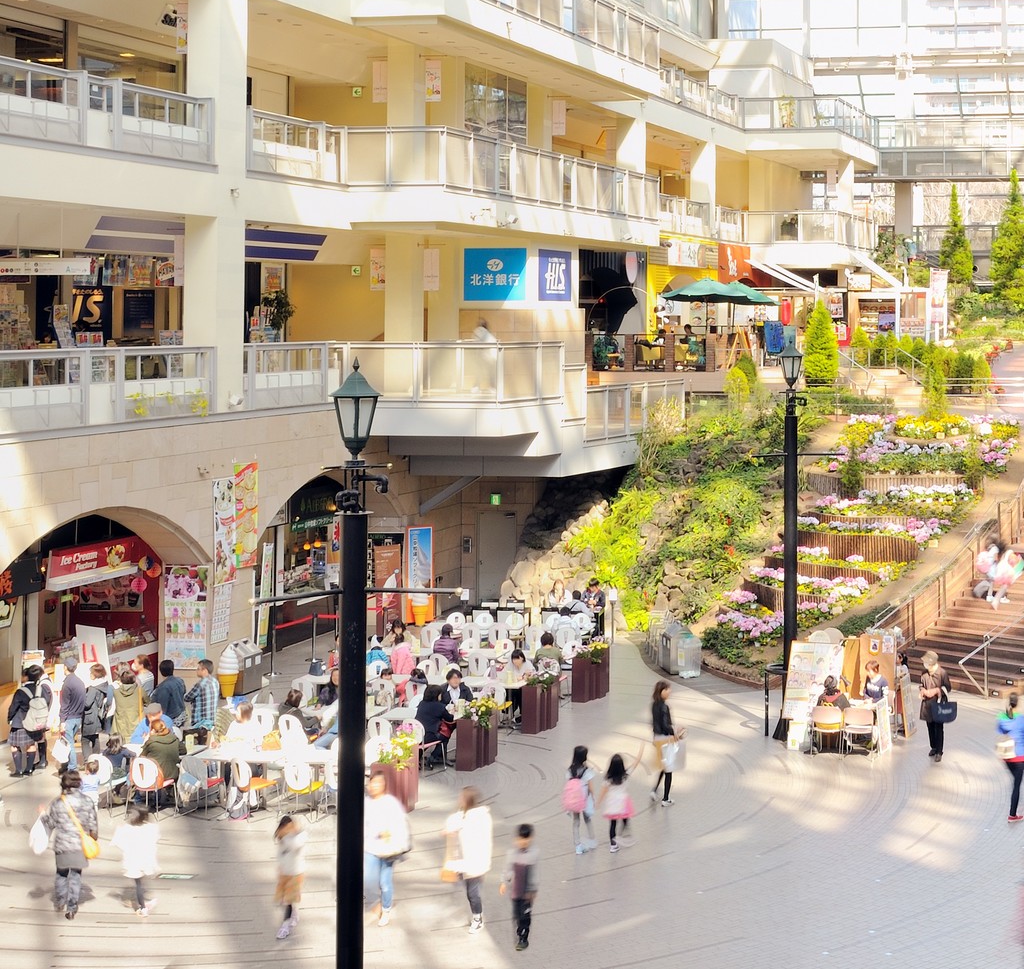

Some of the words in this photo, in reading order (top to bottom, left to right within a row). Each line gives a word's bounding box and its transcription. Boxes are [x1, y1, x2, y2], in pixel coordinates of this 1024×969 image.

[470, 273, 520, 286] 北洋銀行
[60, 555, 73, 566] Ice
[73, 551, 98, 564] Cream
[75, 560, 97, 571] Factory
